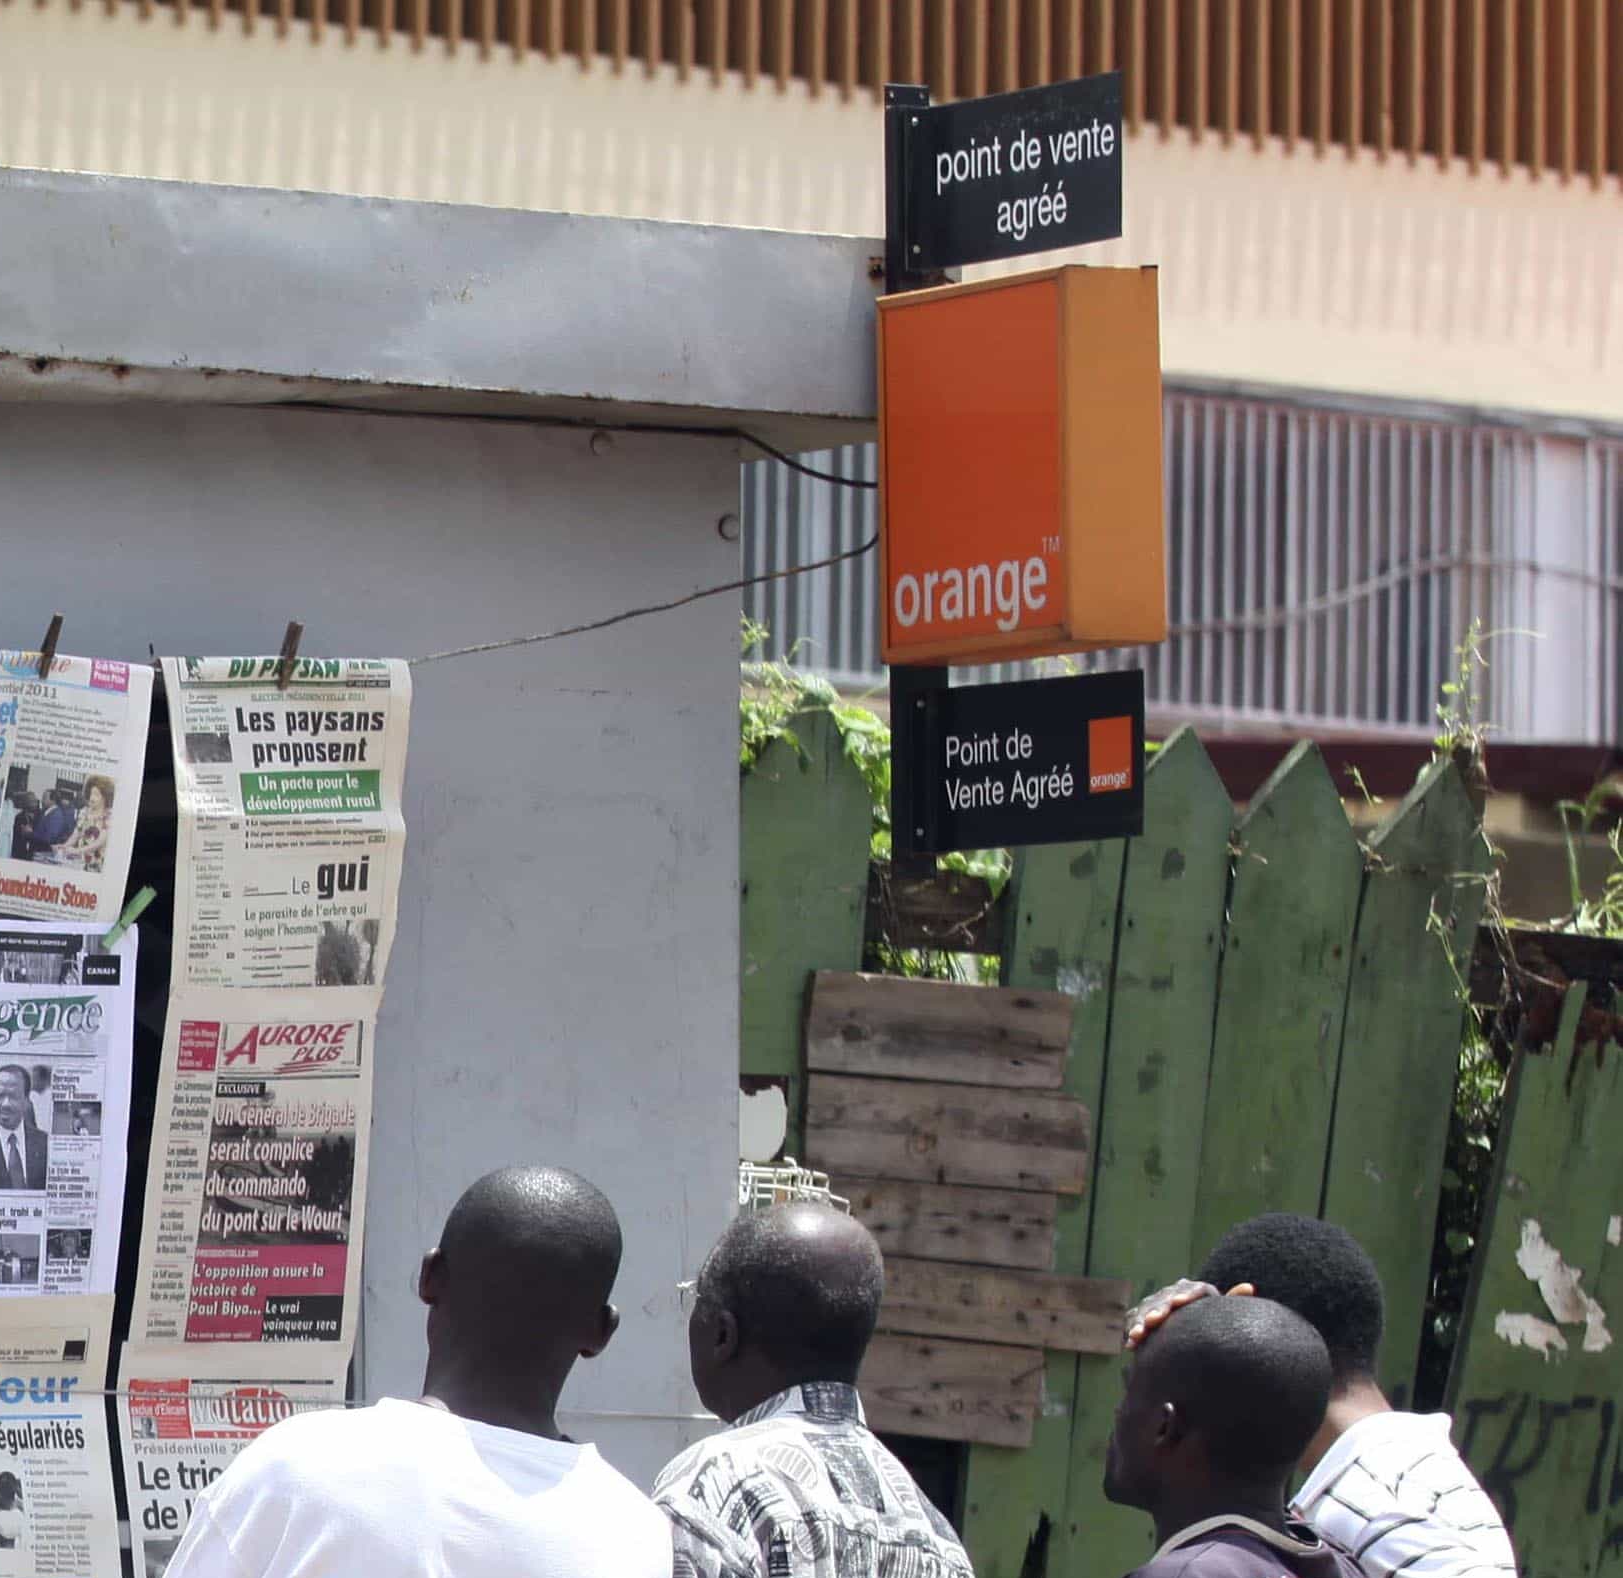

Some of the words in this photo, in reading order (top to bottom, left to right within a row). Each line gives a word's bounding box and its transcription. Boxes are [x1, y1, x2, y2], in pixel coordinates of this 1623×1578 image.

[937, 136, 1001, 196] point
[1010, 129, 1041, 173] de
[1049, 118, 1115, 165] vente
[997, 180, 1066, 241] agréé
[894, 557, 1047, 632] orange
[228, 659, 254, 678] DU
[236, 707, 275, 733] Les
[286, 710, 384, 737] paysans
[253, 737, 367, 767] proposent
[945, 732, 999, 769] Point
[1005, 728, 1033, 760] de
[258, 776, 277, 791] Un
[317, 778, 343, 792] pour
[945, 775, 1004, 811] Vente
[1010, 763, 1074, 809] Agréé
[1090, 771, 1127, 789] orange
[292, 876, 310, 896] Le
[317, 856, 370, 901] gui
[224, 1023, 353, 1065] AURORE
[292, 1046, 343, 1061] PLUS
[210, 1136, 251, 1161] serait
[254, 1136, 314, 1167] complice
[223, 1212, 258, 1239] pont
[273, 1267, 309, 1278] assure
[192, 1283, 237, 1297] victoire
[189, 1301, 218, 1316] Paul
[138, 1461, 171, 1491] Le
[142, 1500, 179, 1530] de
